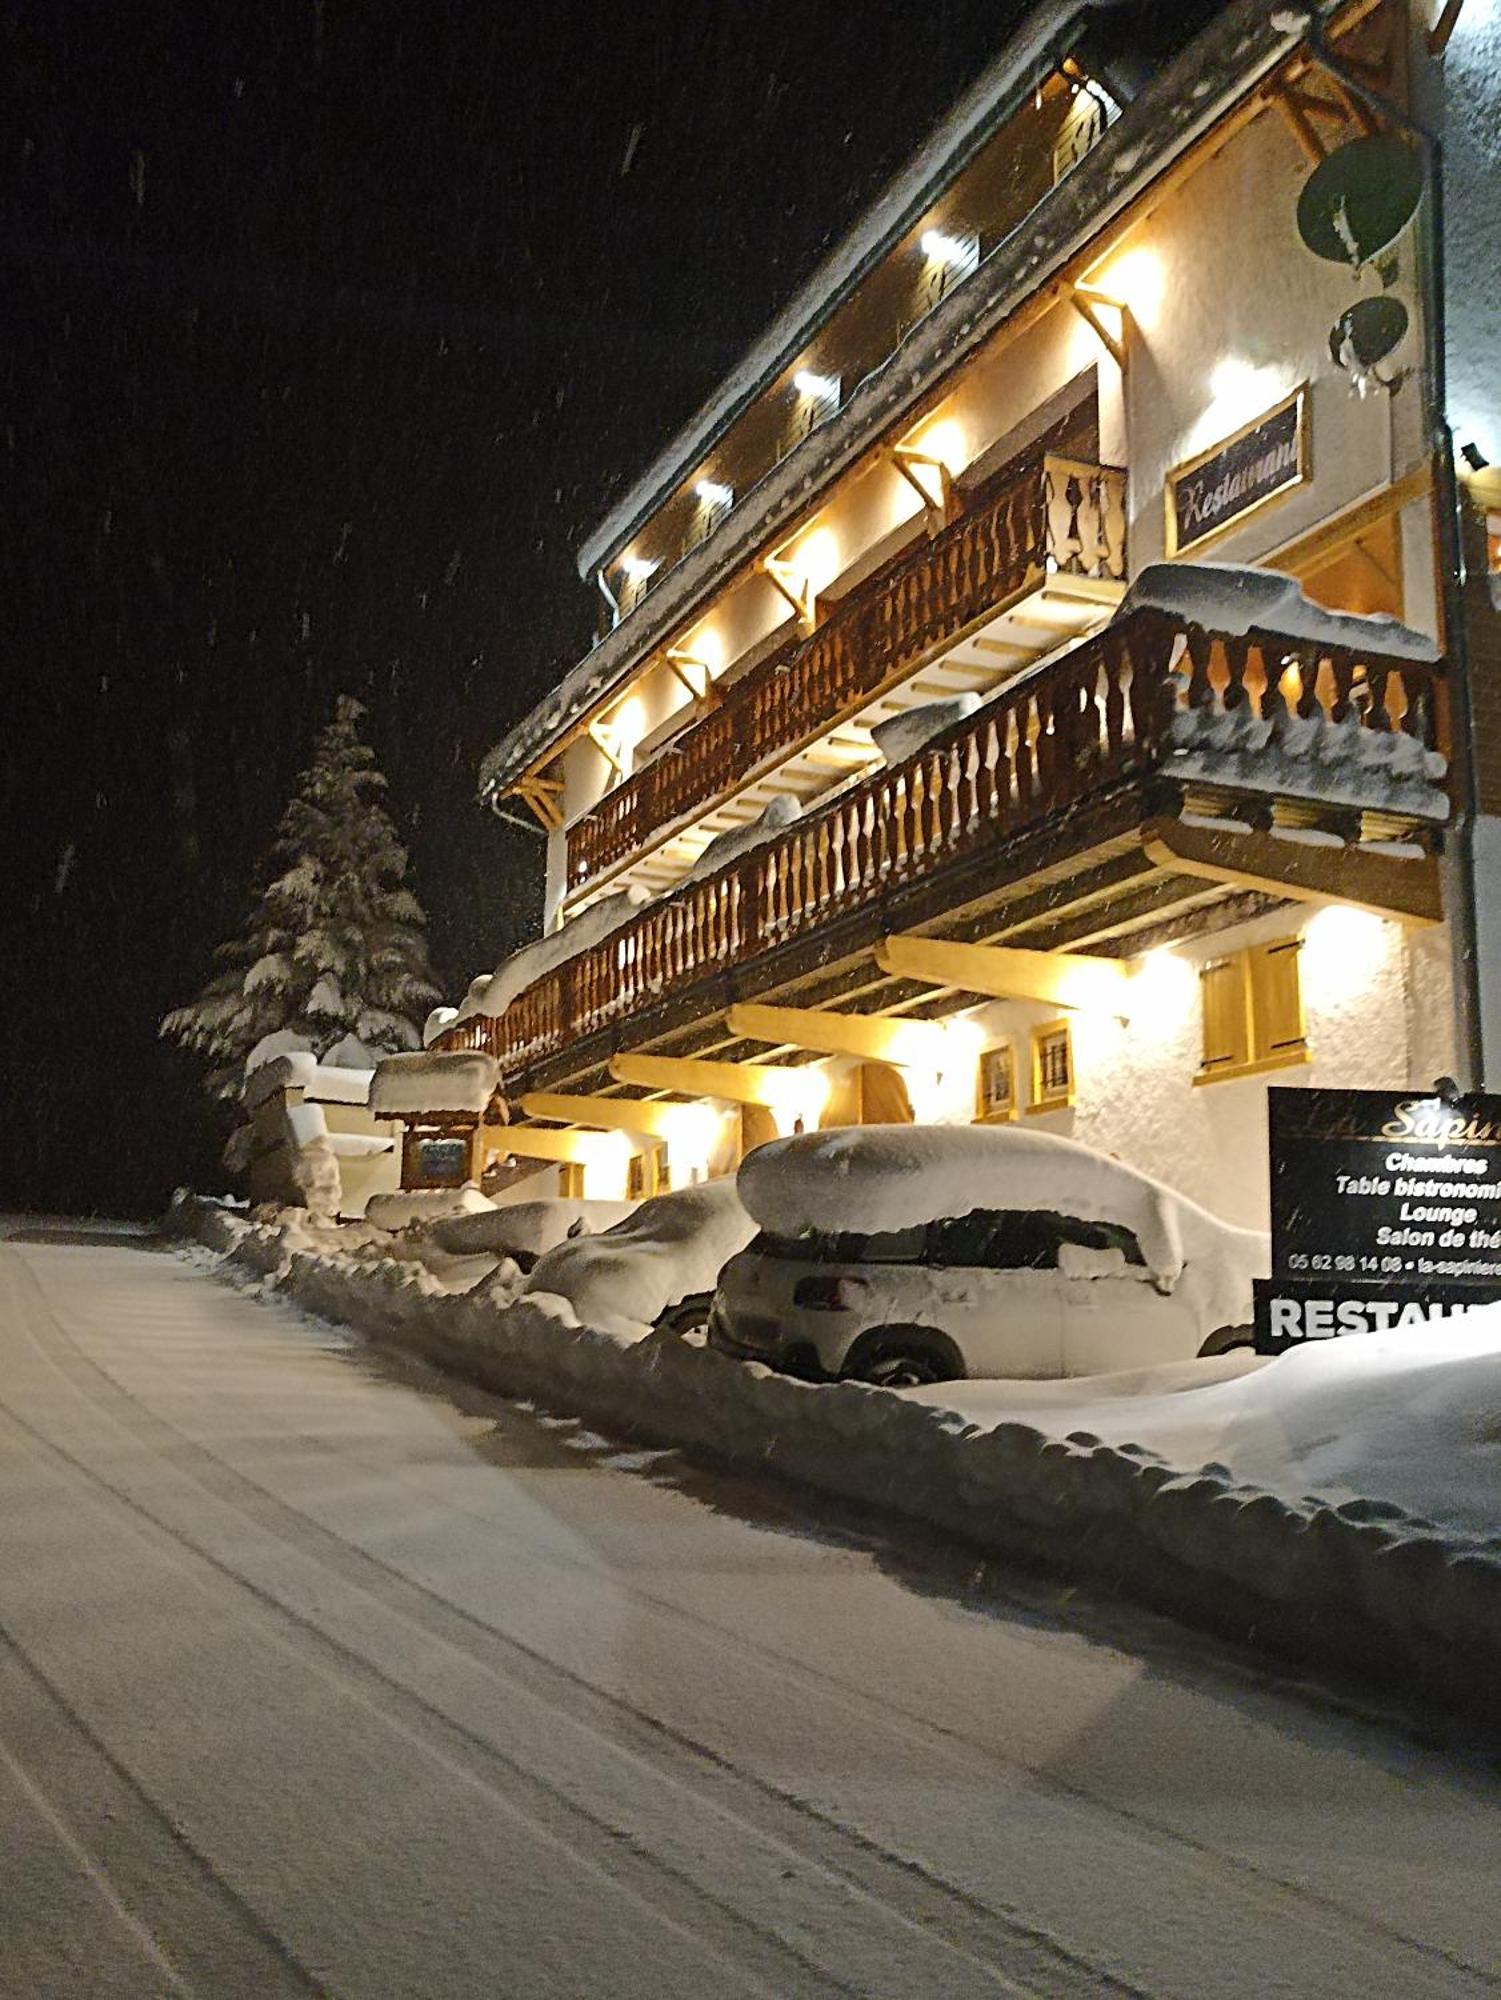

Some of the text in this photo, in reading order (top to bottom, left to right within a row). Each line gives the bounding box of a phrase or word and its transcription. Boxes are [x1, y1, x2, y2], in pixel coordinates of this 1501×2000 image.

[1385, 1152, 1488, 1175] Chambres
[1336, 1175, 1391, 1196] Table
[1400, 1202, 1478, 1226] Lounge
[1376, 1226, 1501, 1249] Salon de thé
[1359, 1256, 1379, 1271] 14
[1269, 1298, 1488, 1338] RESTA
